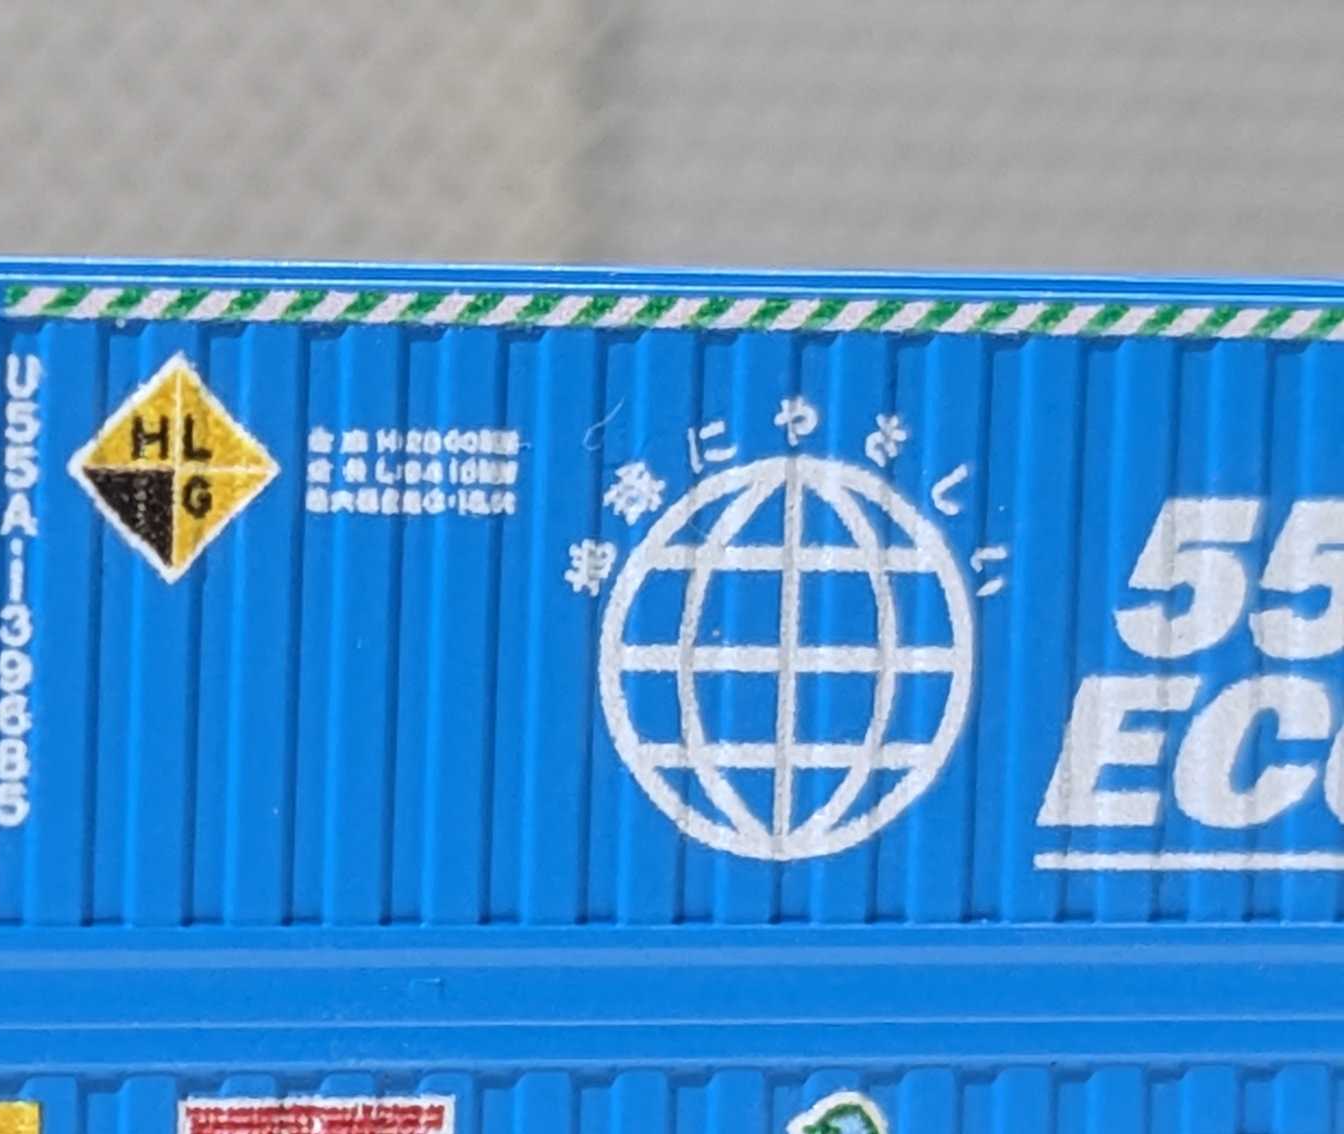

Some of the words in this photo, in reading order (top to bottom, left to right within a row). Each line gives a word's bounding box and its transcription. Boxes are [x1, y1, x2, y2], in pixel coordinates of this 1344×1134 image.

[182, 475, 213, 519] G
[1113, 498, 1344, 660] 55
[1035, 673, 1344, 829] EC
